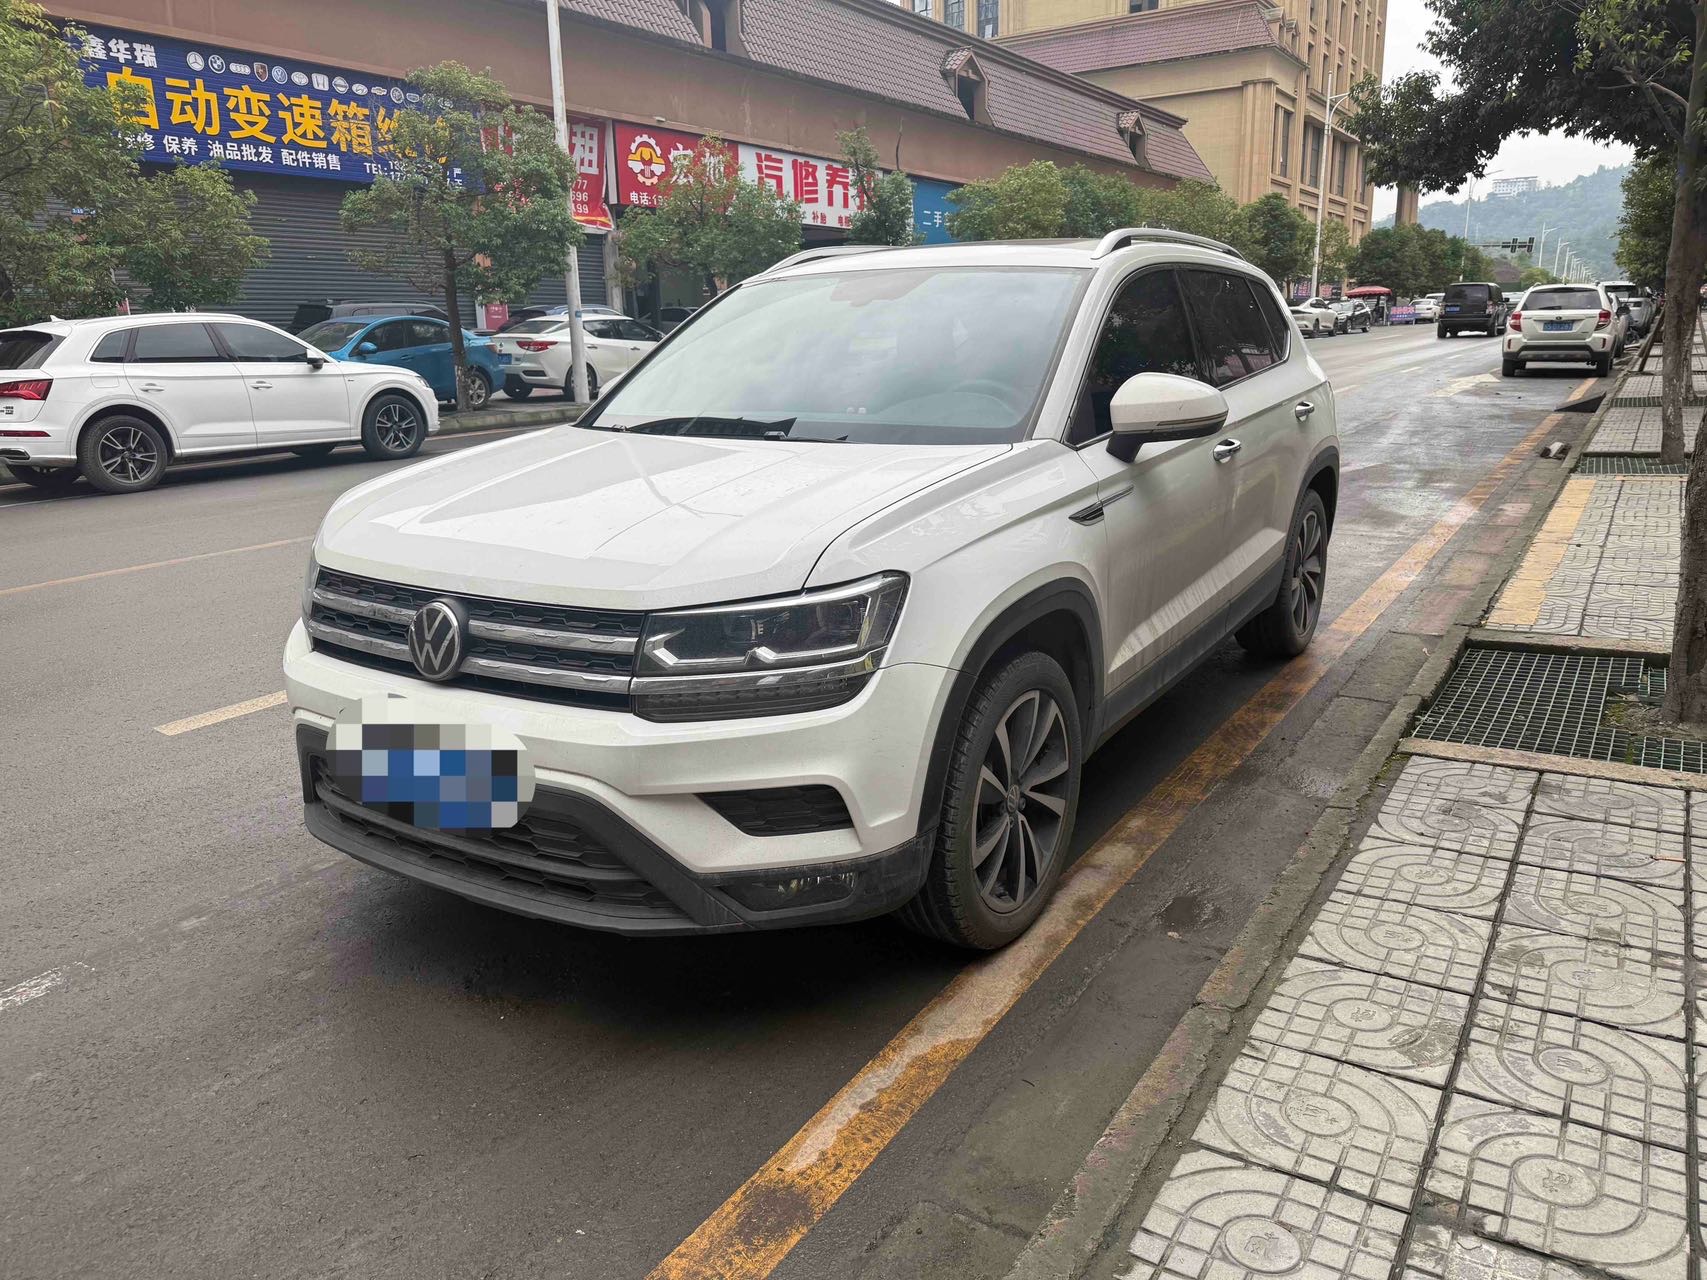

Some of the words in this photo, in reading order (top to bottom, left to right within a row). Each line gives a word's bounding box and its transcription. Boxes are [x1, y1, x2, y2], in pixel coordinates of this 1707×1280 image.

[85, 34, 157, 68] 鑫华瑞
[106, 66, 448, 165] 自动变速箱
[163, 134, 199, 156] 保养
[207, 140, 274, 164] 油品批发
[281, 148, 341, 171] 配件销售
